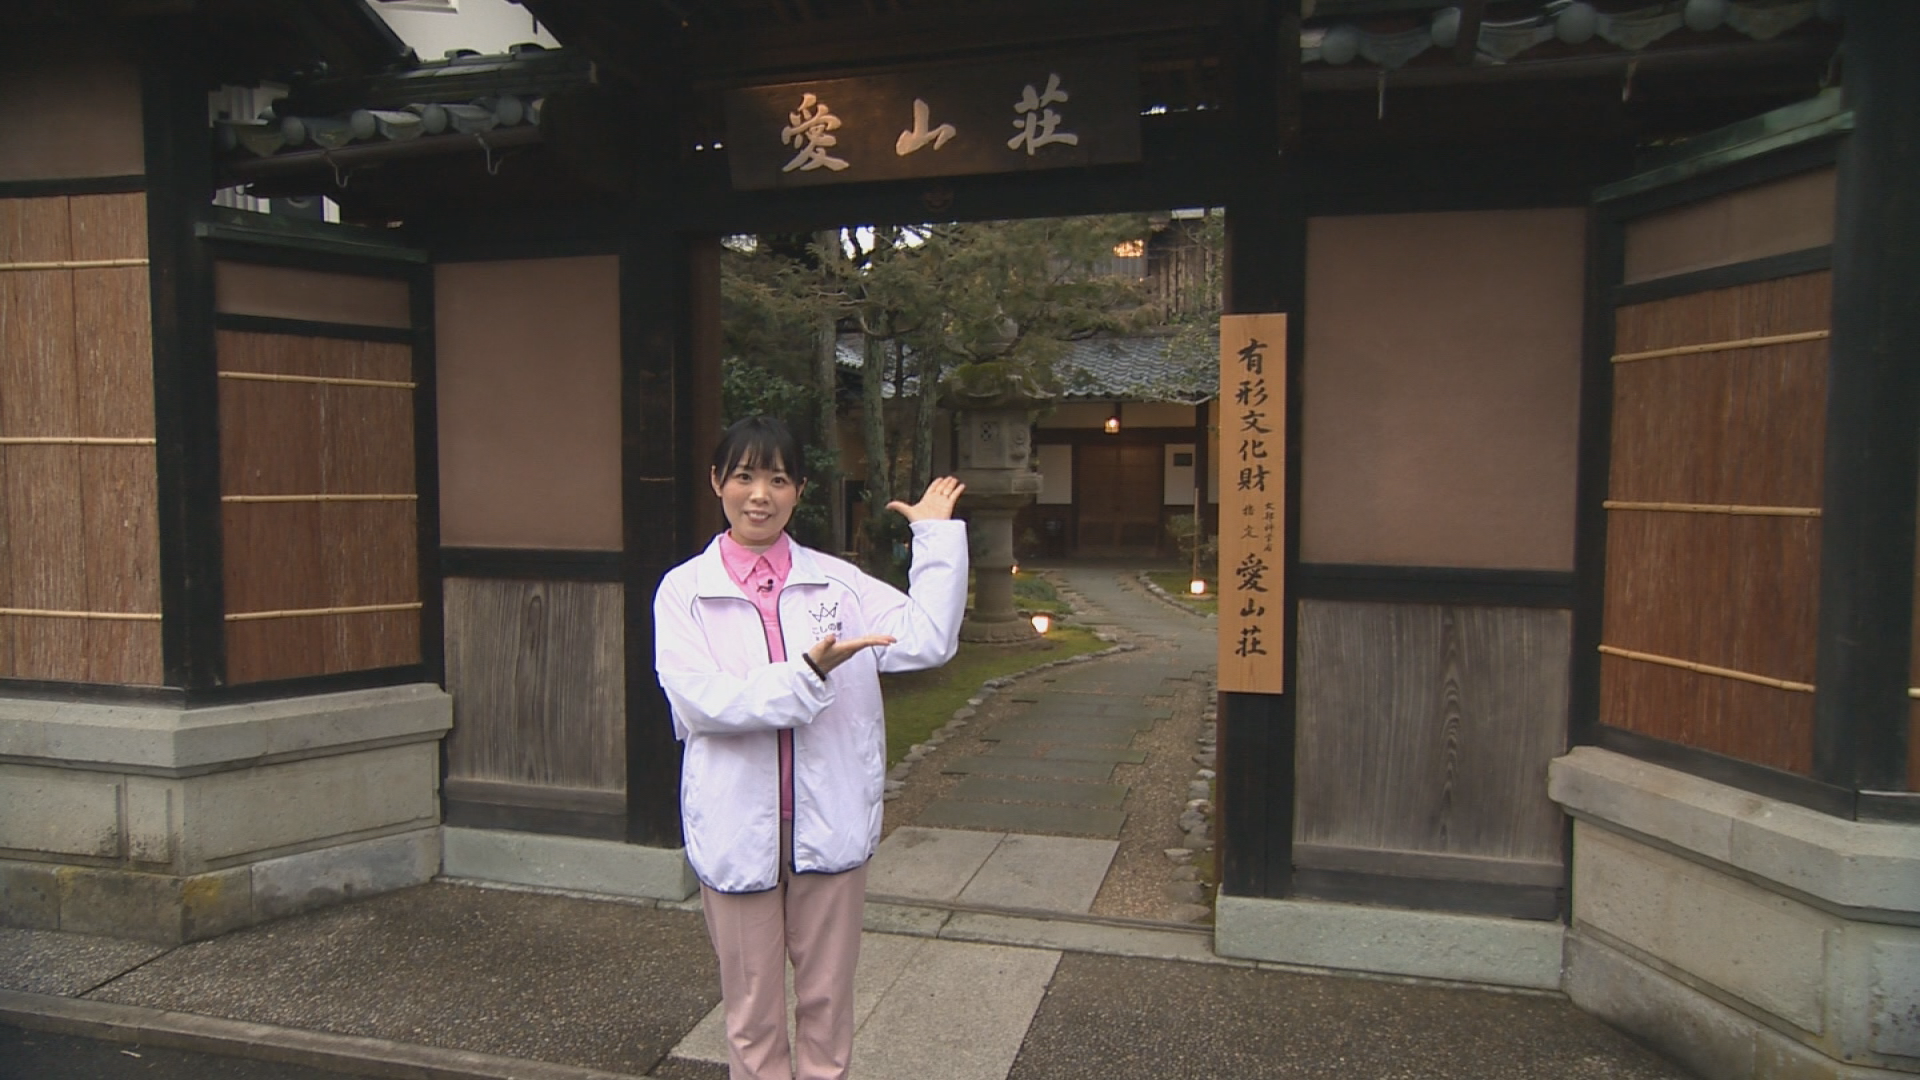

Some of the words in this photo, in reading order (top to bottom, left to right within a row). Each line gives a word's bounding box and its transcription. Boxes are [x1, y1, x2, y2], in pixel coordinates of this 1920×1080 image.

[781, 73, 1079, 173] 愛山荘
[1234, 337, 1272, 493] 有形文化財
[1235, 552, 1269, 658] 愛山荘
